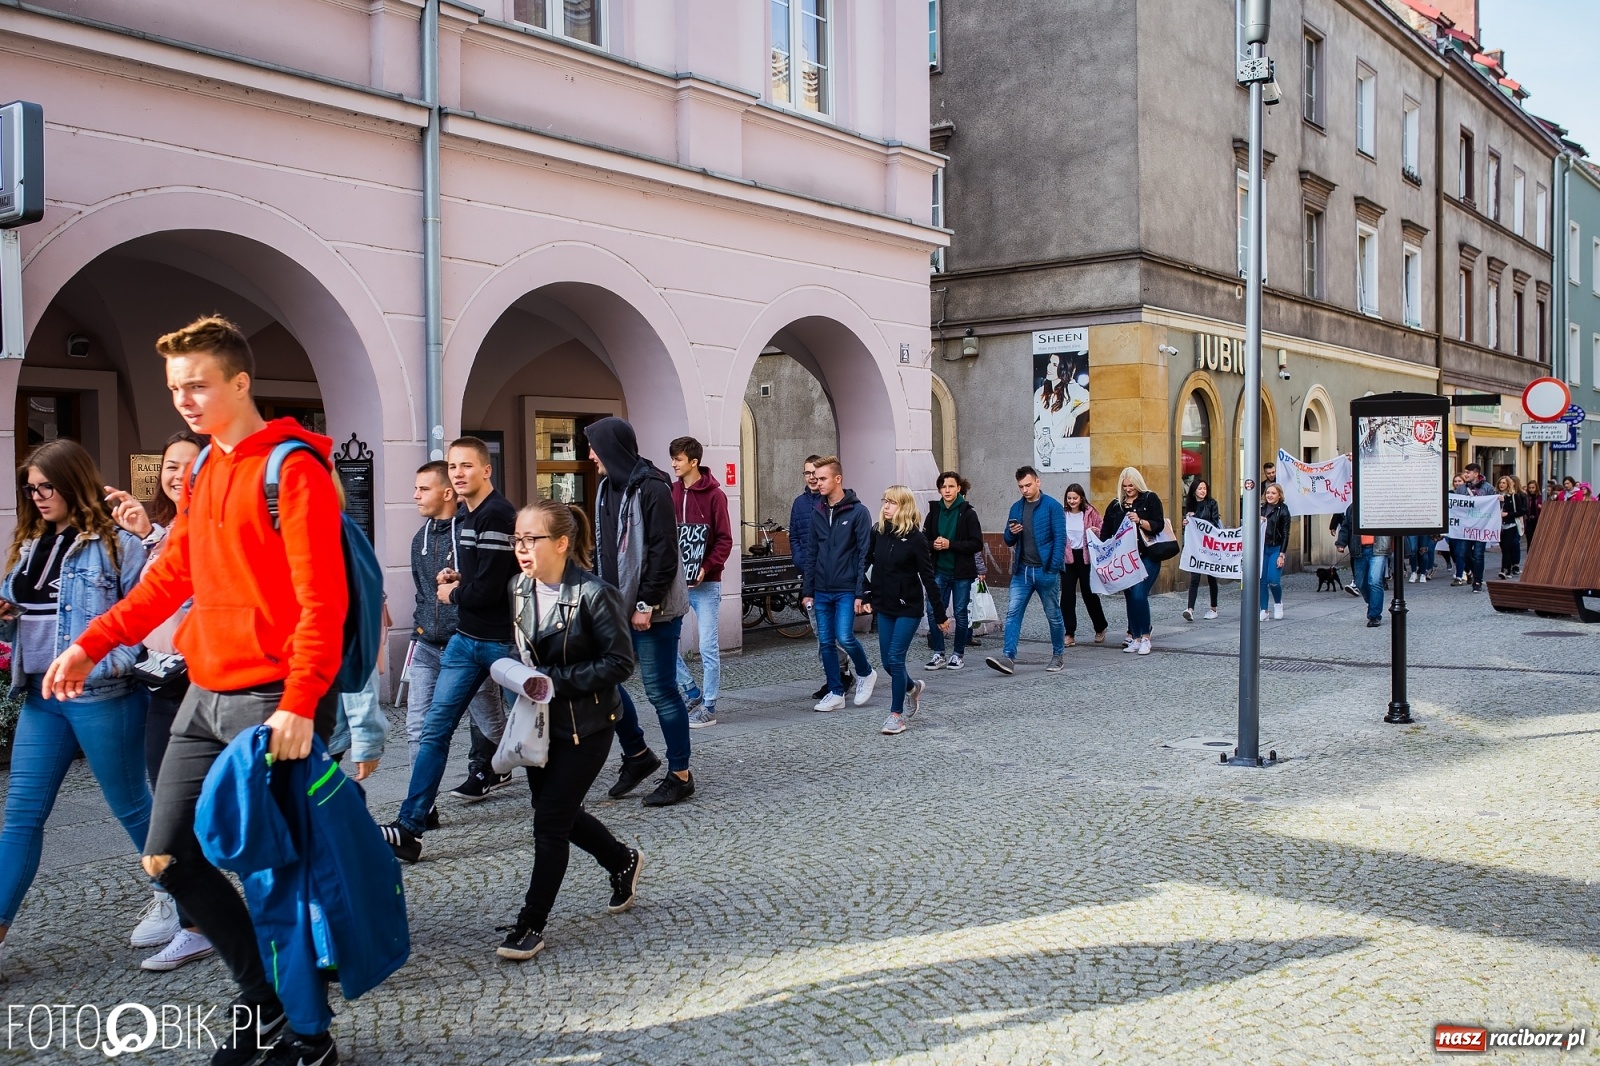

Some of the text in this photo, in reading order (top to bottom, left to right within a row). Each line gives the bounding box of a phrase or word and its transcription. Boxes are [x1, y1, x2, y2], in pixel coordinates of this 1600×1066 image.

[1038, 332, 1083, 344] SHEEN
[1195, 520, 1242, 538] YOU ARE
[1202, 534, 1243, 552] NEVER
